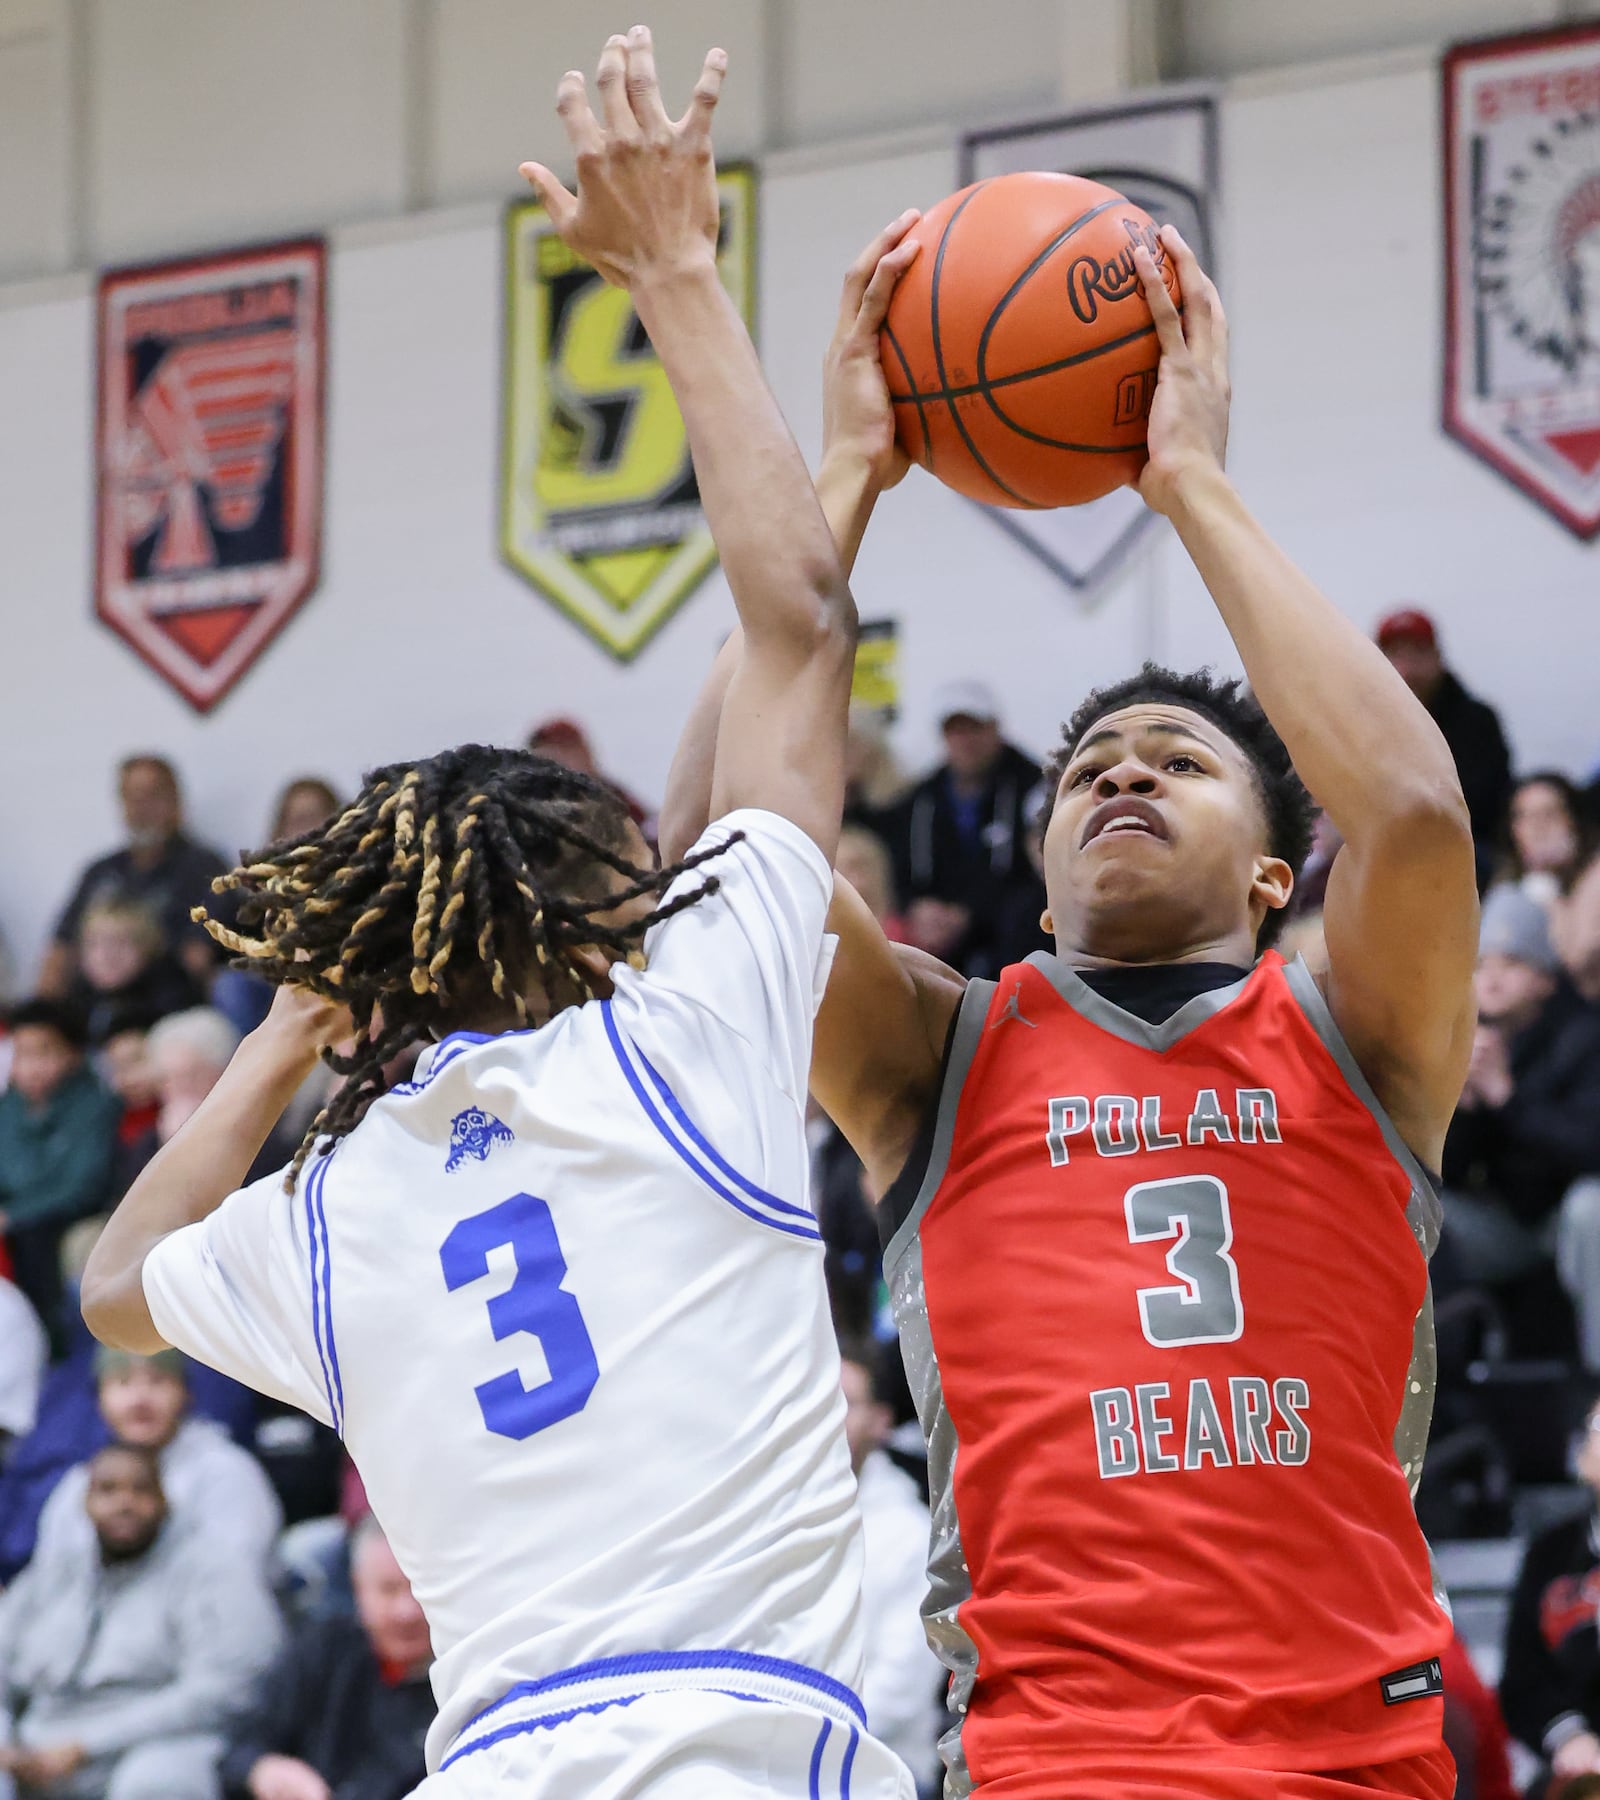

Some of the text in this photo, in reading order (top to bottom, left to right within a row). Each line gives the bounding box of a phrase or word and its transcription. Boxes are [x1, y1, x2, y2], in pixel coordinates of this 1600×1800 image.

[1046, 1088, 1283, 1167] POLAR
[439, 1192, 600, 1441] 3
[1124, 1174, 1244, 1349] 3
[1089, 1376, 1311, 1480] BEARS
